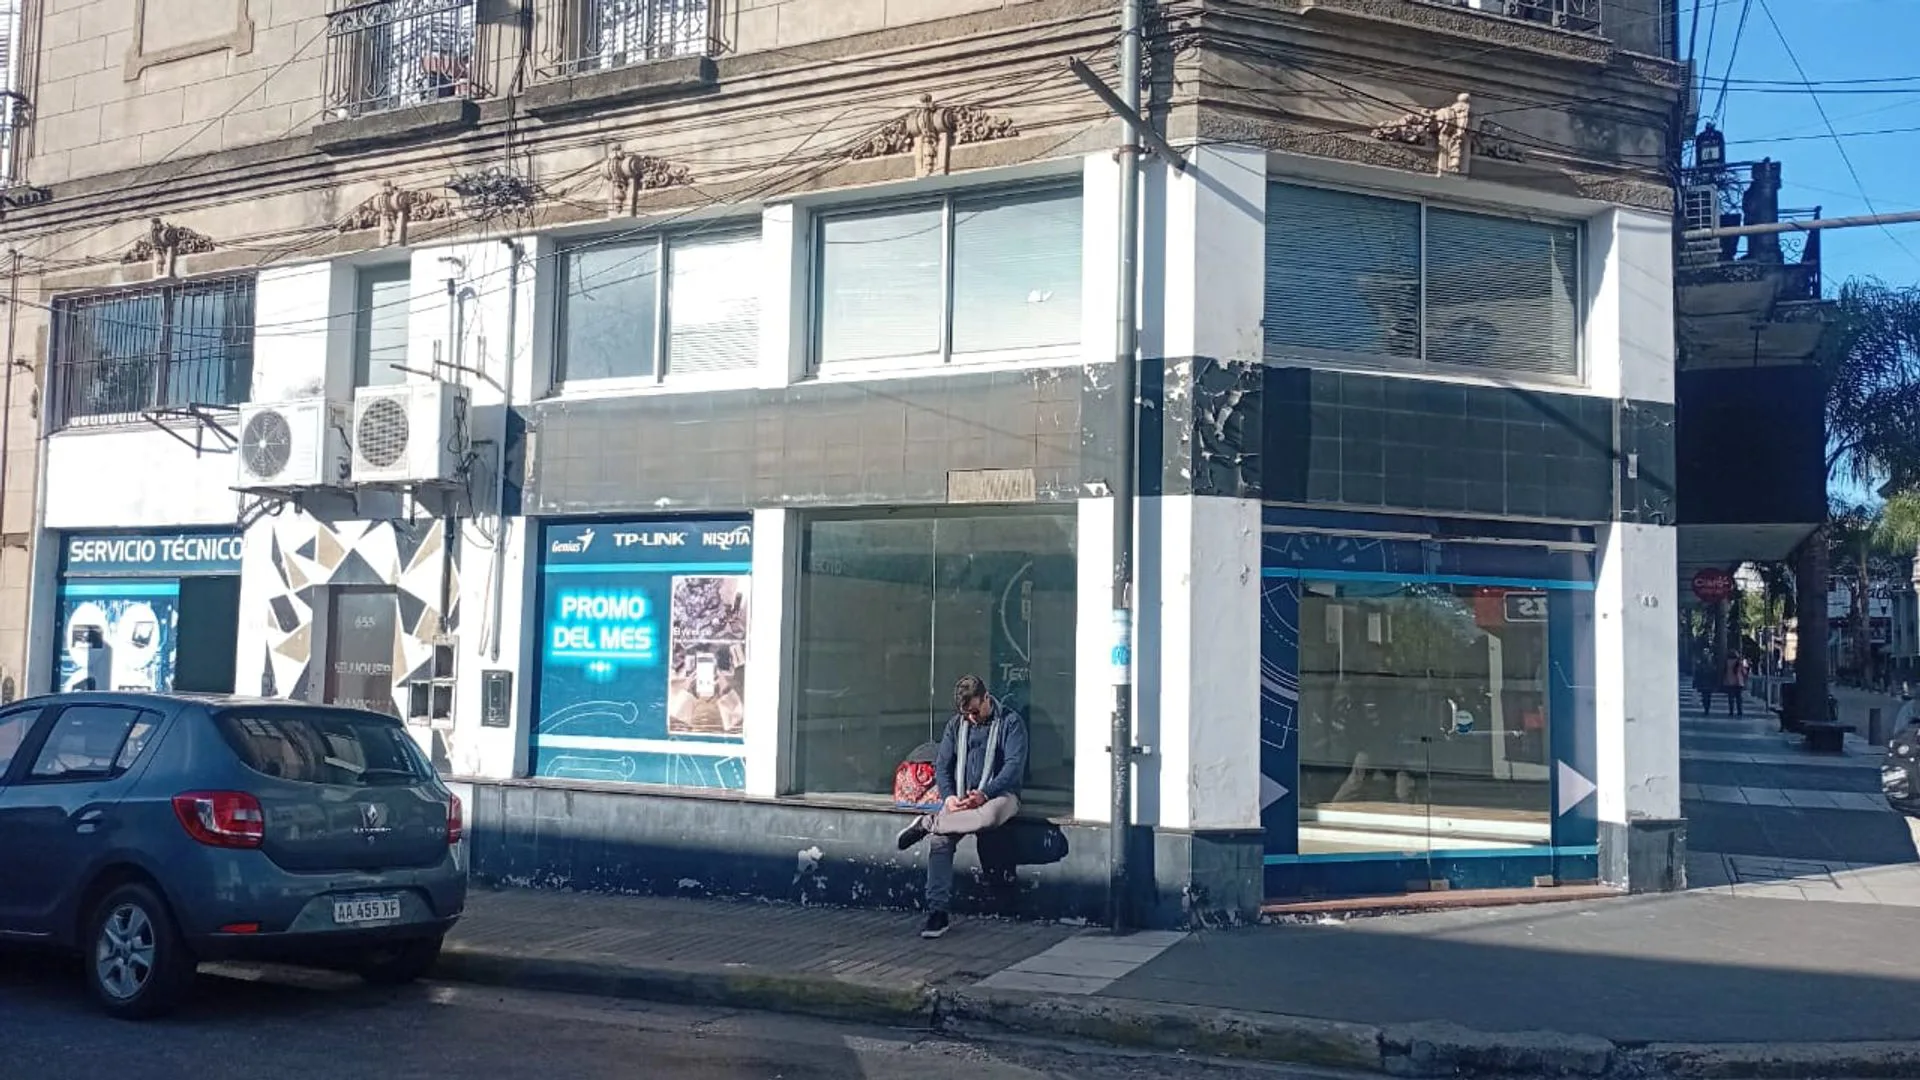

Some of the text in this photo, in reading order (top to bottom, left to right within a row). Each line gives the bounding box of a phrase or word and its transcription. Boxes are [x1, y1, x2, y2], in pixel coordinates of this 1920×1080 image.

[70, 534, 244, 563] SERVICIO TÉCNICO
[551, 539, 582, 554] Genius
[612, 531, 688, 547] TP-LINK
[561, 595, 645, 620] PROMO
[553, 626, 596, 649] DEL
[600, 627, 651, 650] MES
[338, 904, 353, 920] AA
[357, 902, 380, 919] 455
